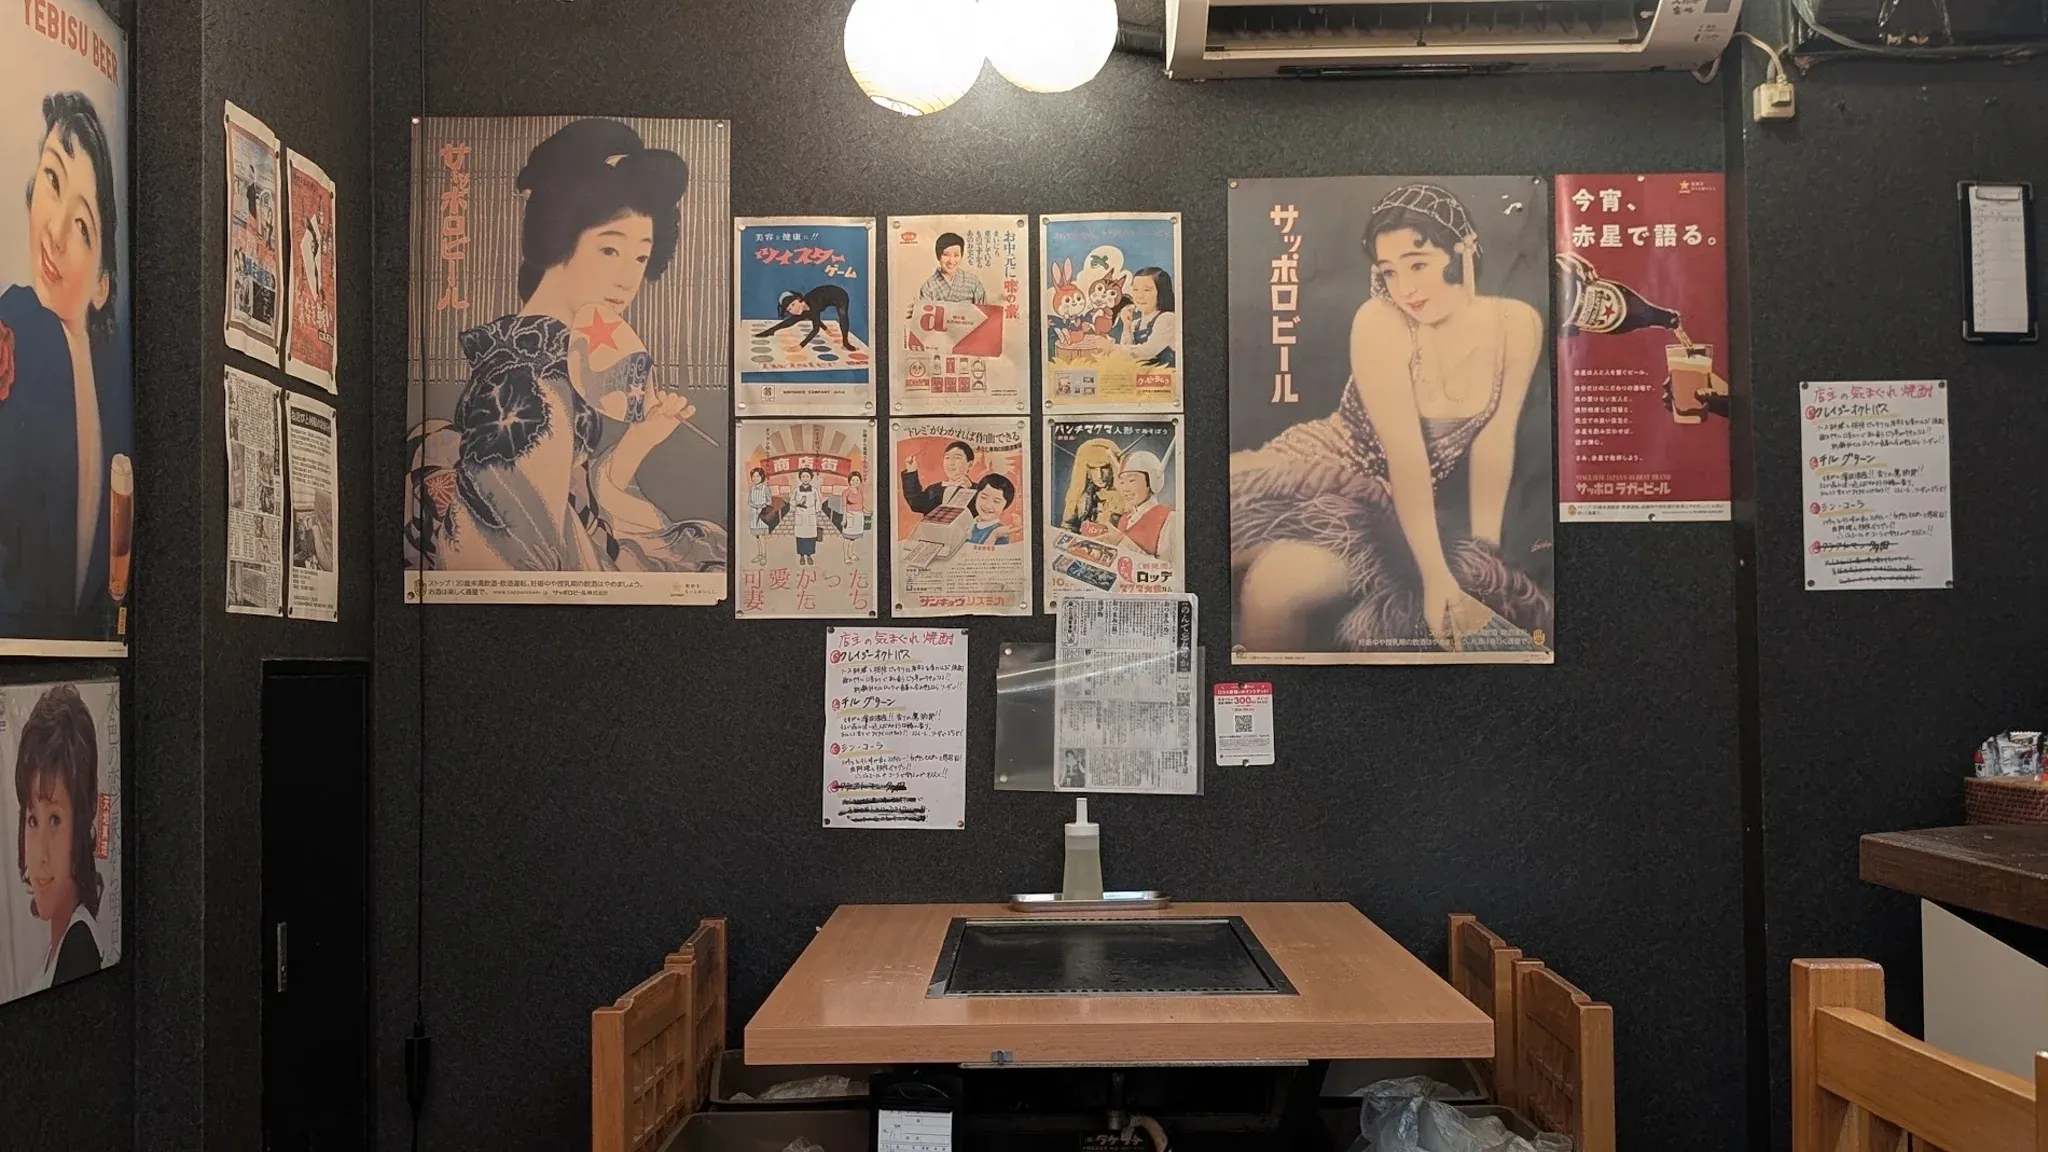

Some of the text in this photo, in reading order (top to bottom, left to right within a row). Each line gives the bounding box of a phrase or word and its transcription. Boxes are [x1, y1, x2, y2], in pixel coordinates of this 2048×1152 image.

[24, 0, 119, 88] YEBISU BEER
[1571, 188, 1637, 212] 今宵、
[437, 143, 472, 310] サッポロビール
[1572, 224, 1717, 248] 赤星で語る。
[825, 264, 857, 278] ゲーム
[1270, 204, 1302, 403] サッポロビール
[773, 456, 839, 471] 商店街
[743, 567, 870, 590] 可愛かった
[1137, 571, 1173, 583] ロッテ
[743, 588, 869, 611] 妻たち
